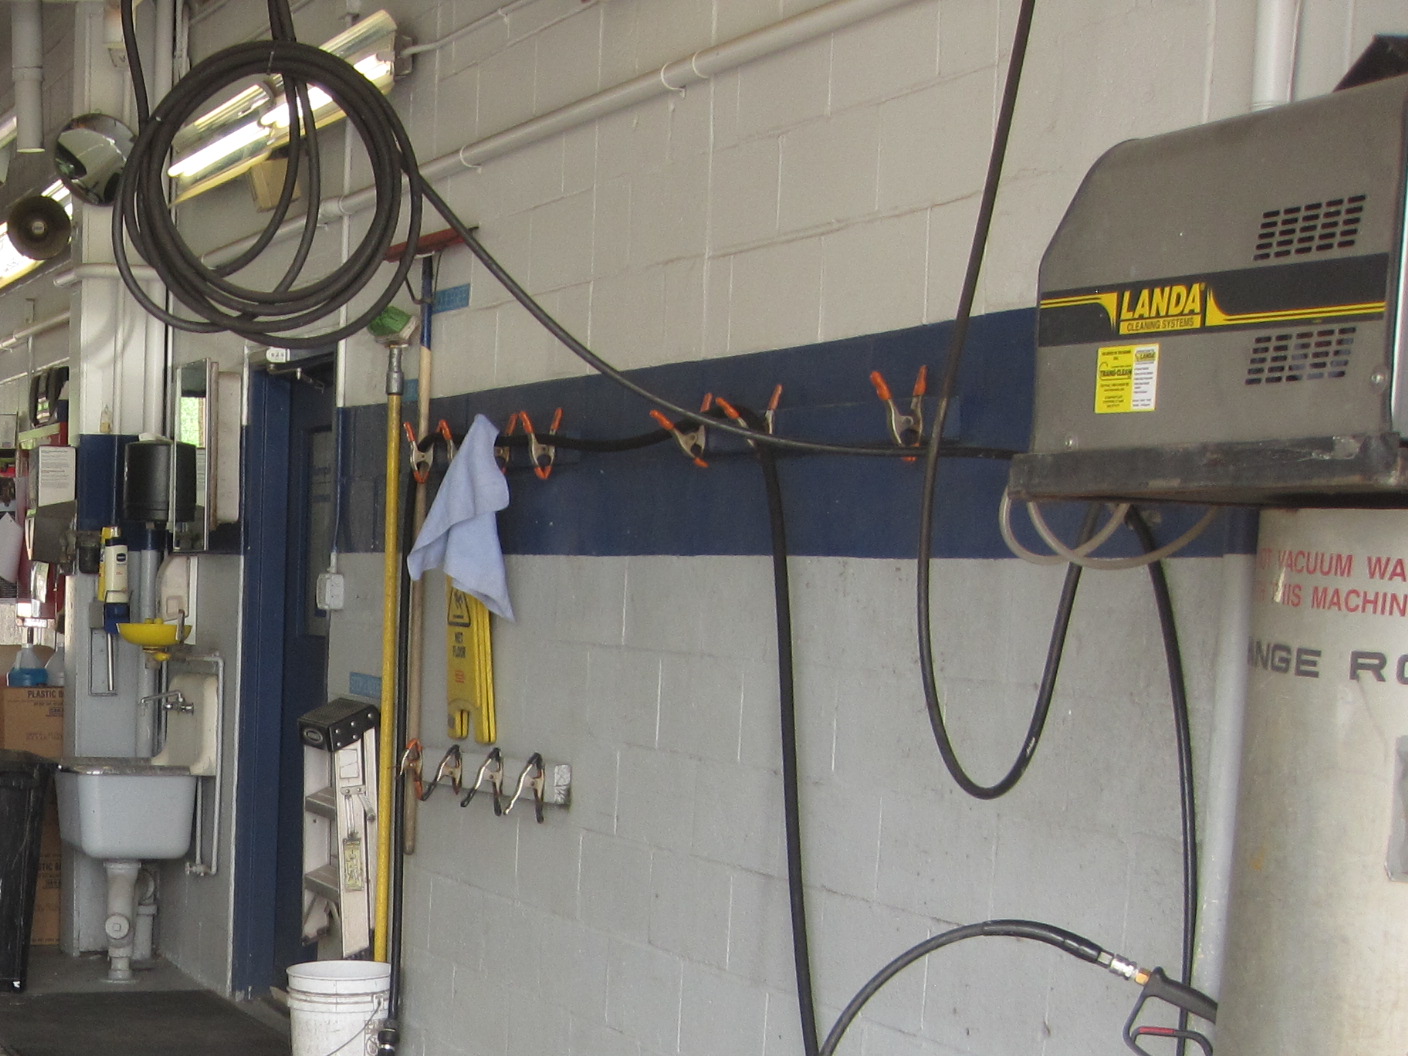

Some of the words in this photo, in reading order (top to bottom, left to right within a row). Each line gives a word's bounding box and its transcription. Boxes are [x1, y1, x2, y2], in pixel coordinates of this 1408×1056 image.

[1120, 283, 1201, 320] LANDA
[1127, 320, 1161, 332] CLEANING
[1162, 317, 1194, 329] SYSTEMS
[1277, 549, 1354, 577] VACUUM
